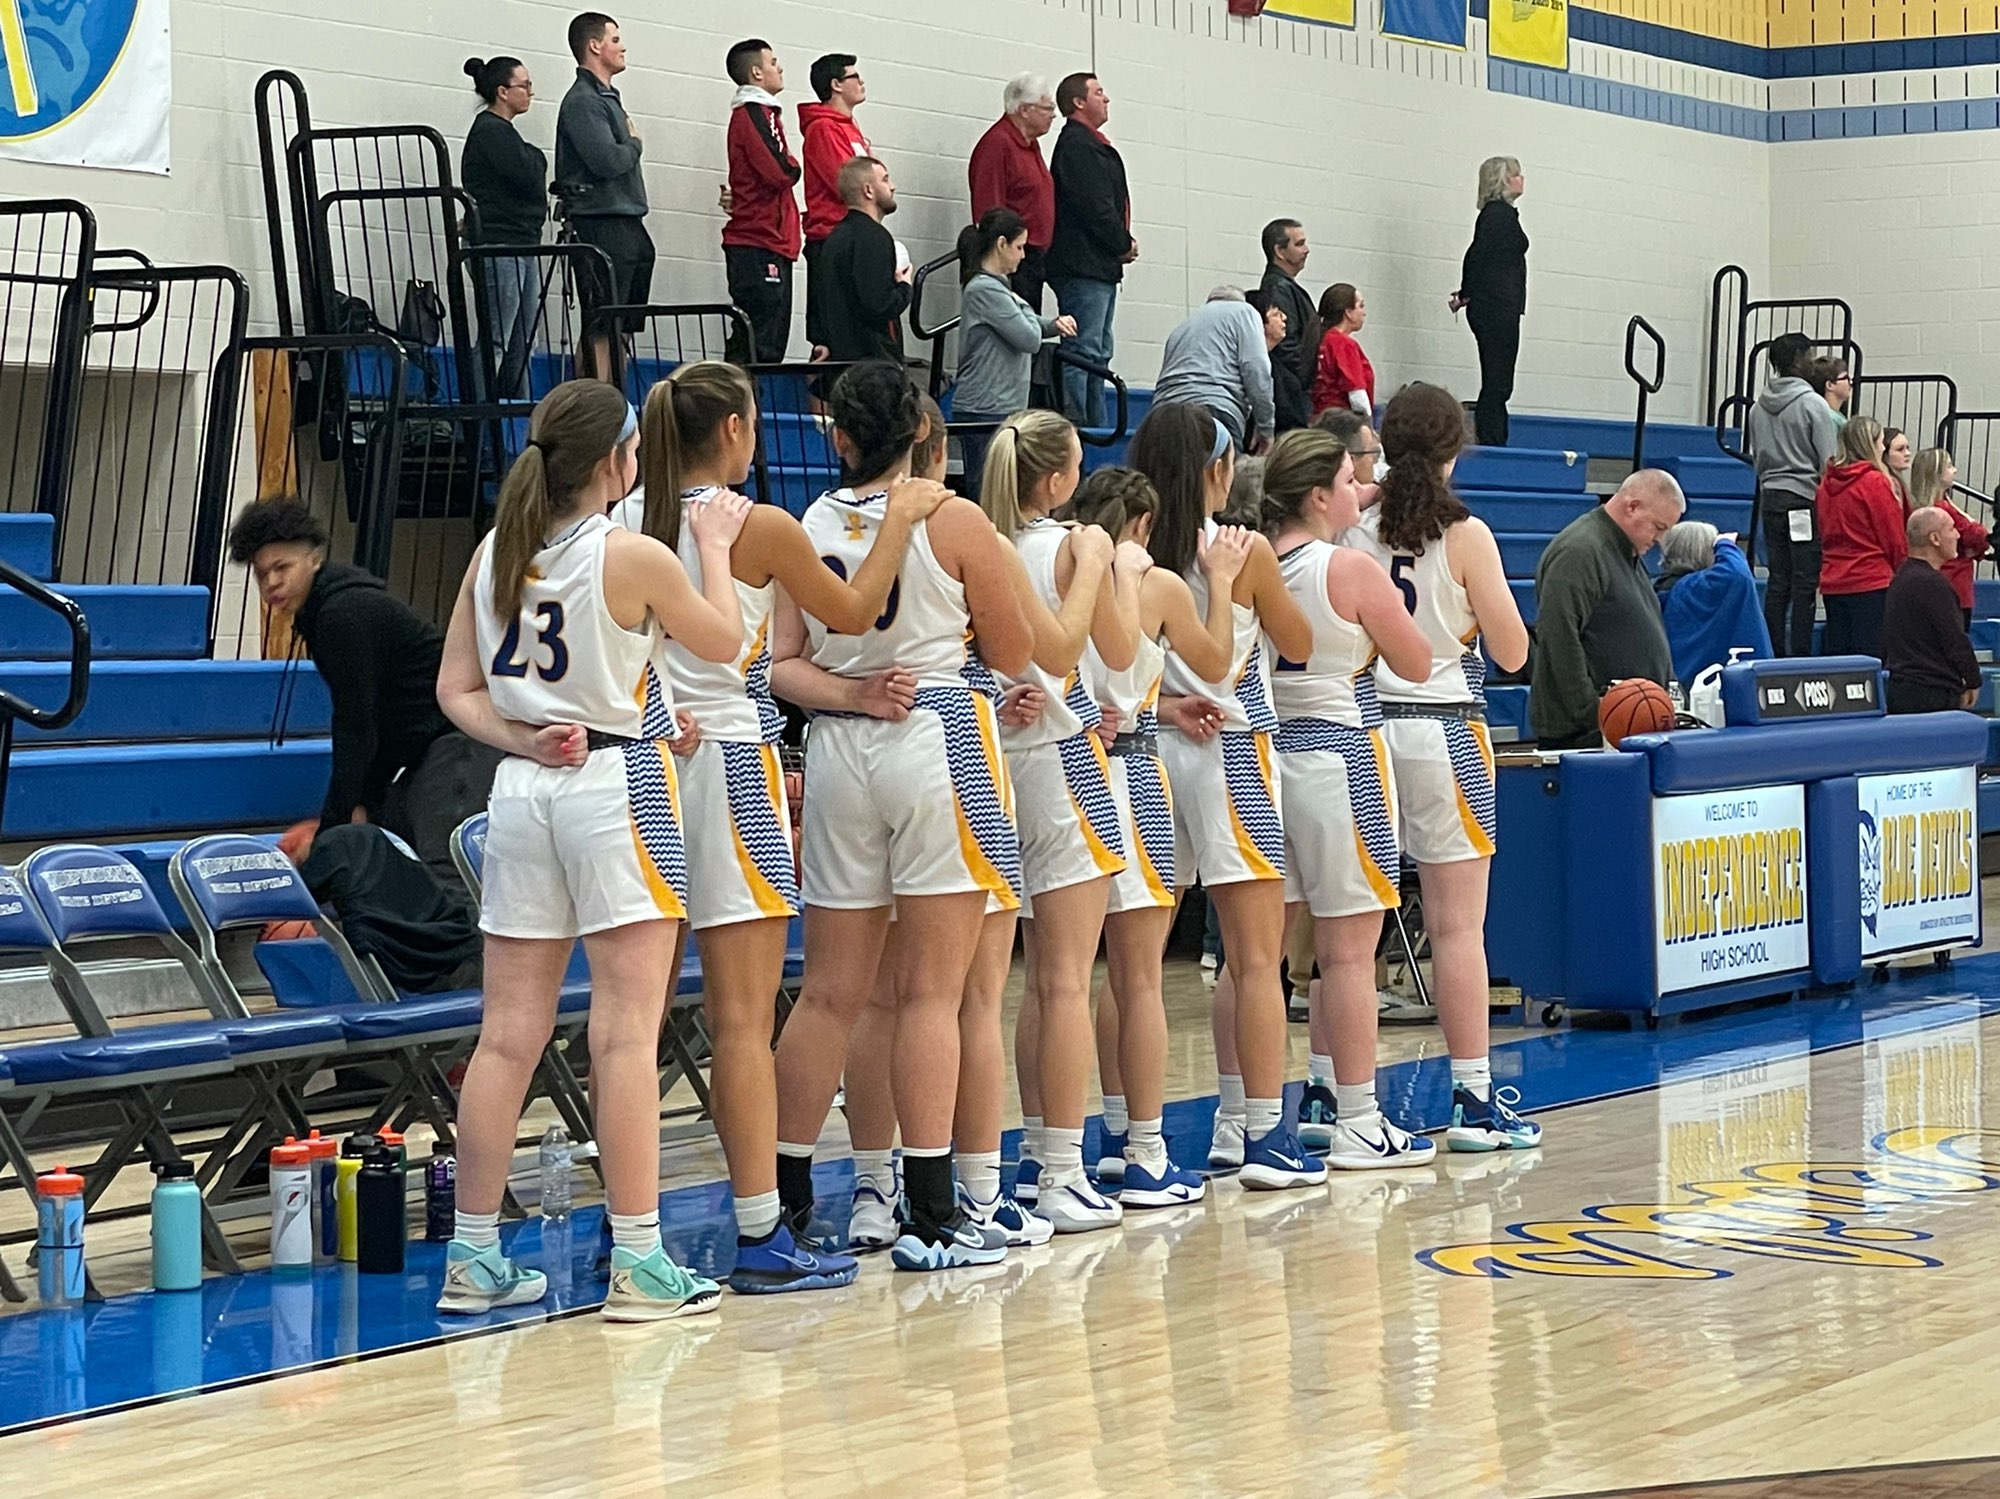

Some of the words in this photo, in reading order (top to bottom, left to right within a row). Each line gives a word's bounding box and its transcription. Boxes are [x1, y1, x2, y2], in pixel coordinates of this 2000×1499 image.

[488, 600, 569, 683] 23
[1804, 681, 1829, 707] POSS
[1886, 783, 1907, 801] HOME
[1908, 782, 1917, 799] OF
[1920, 781, 1932, 797] THE
[1705, 802, 1745, 821] WELCOME
[1747, 800, 1758, 817] TO
[1882, 814, 1916, 910] BLUE
[1920, 808, 1972, 903] DEVILS
[1661, 827, 1803, 945] INDEPENDENCE
[1701, 948, 1726, 972] HIGH
[1728, 942, 1769, 968] SCHOOL
